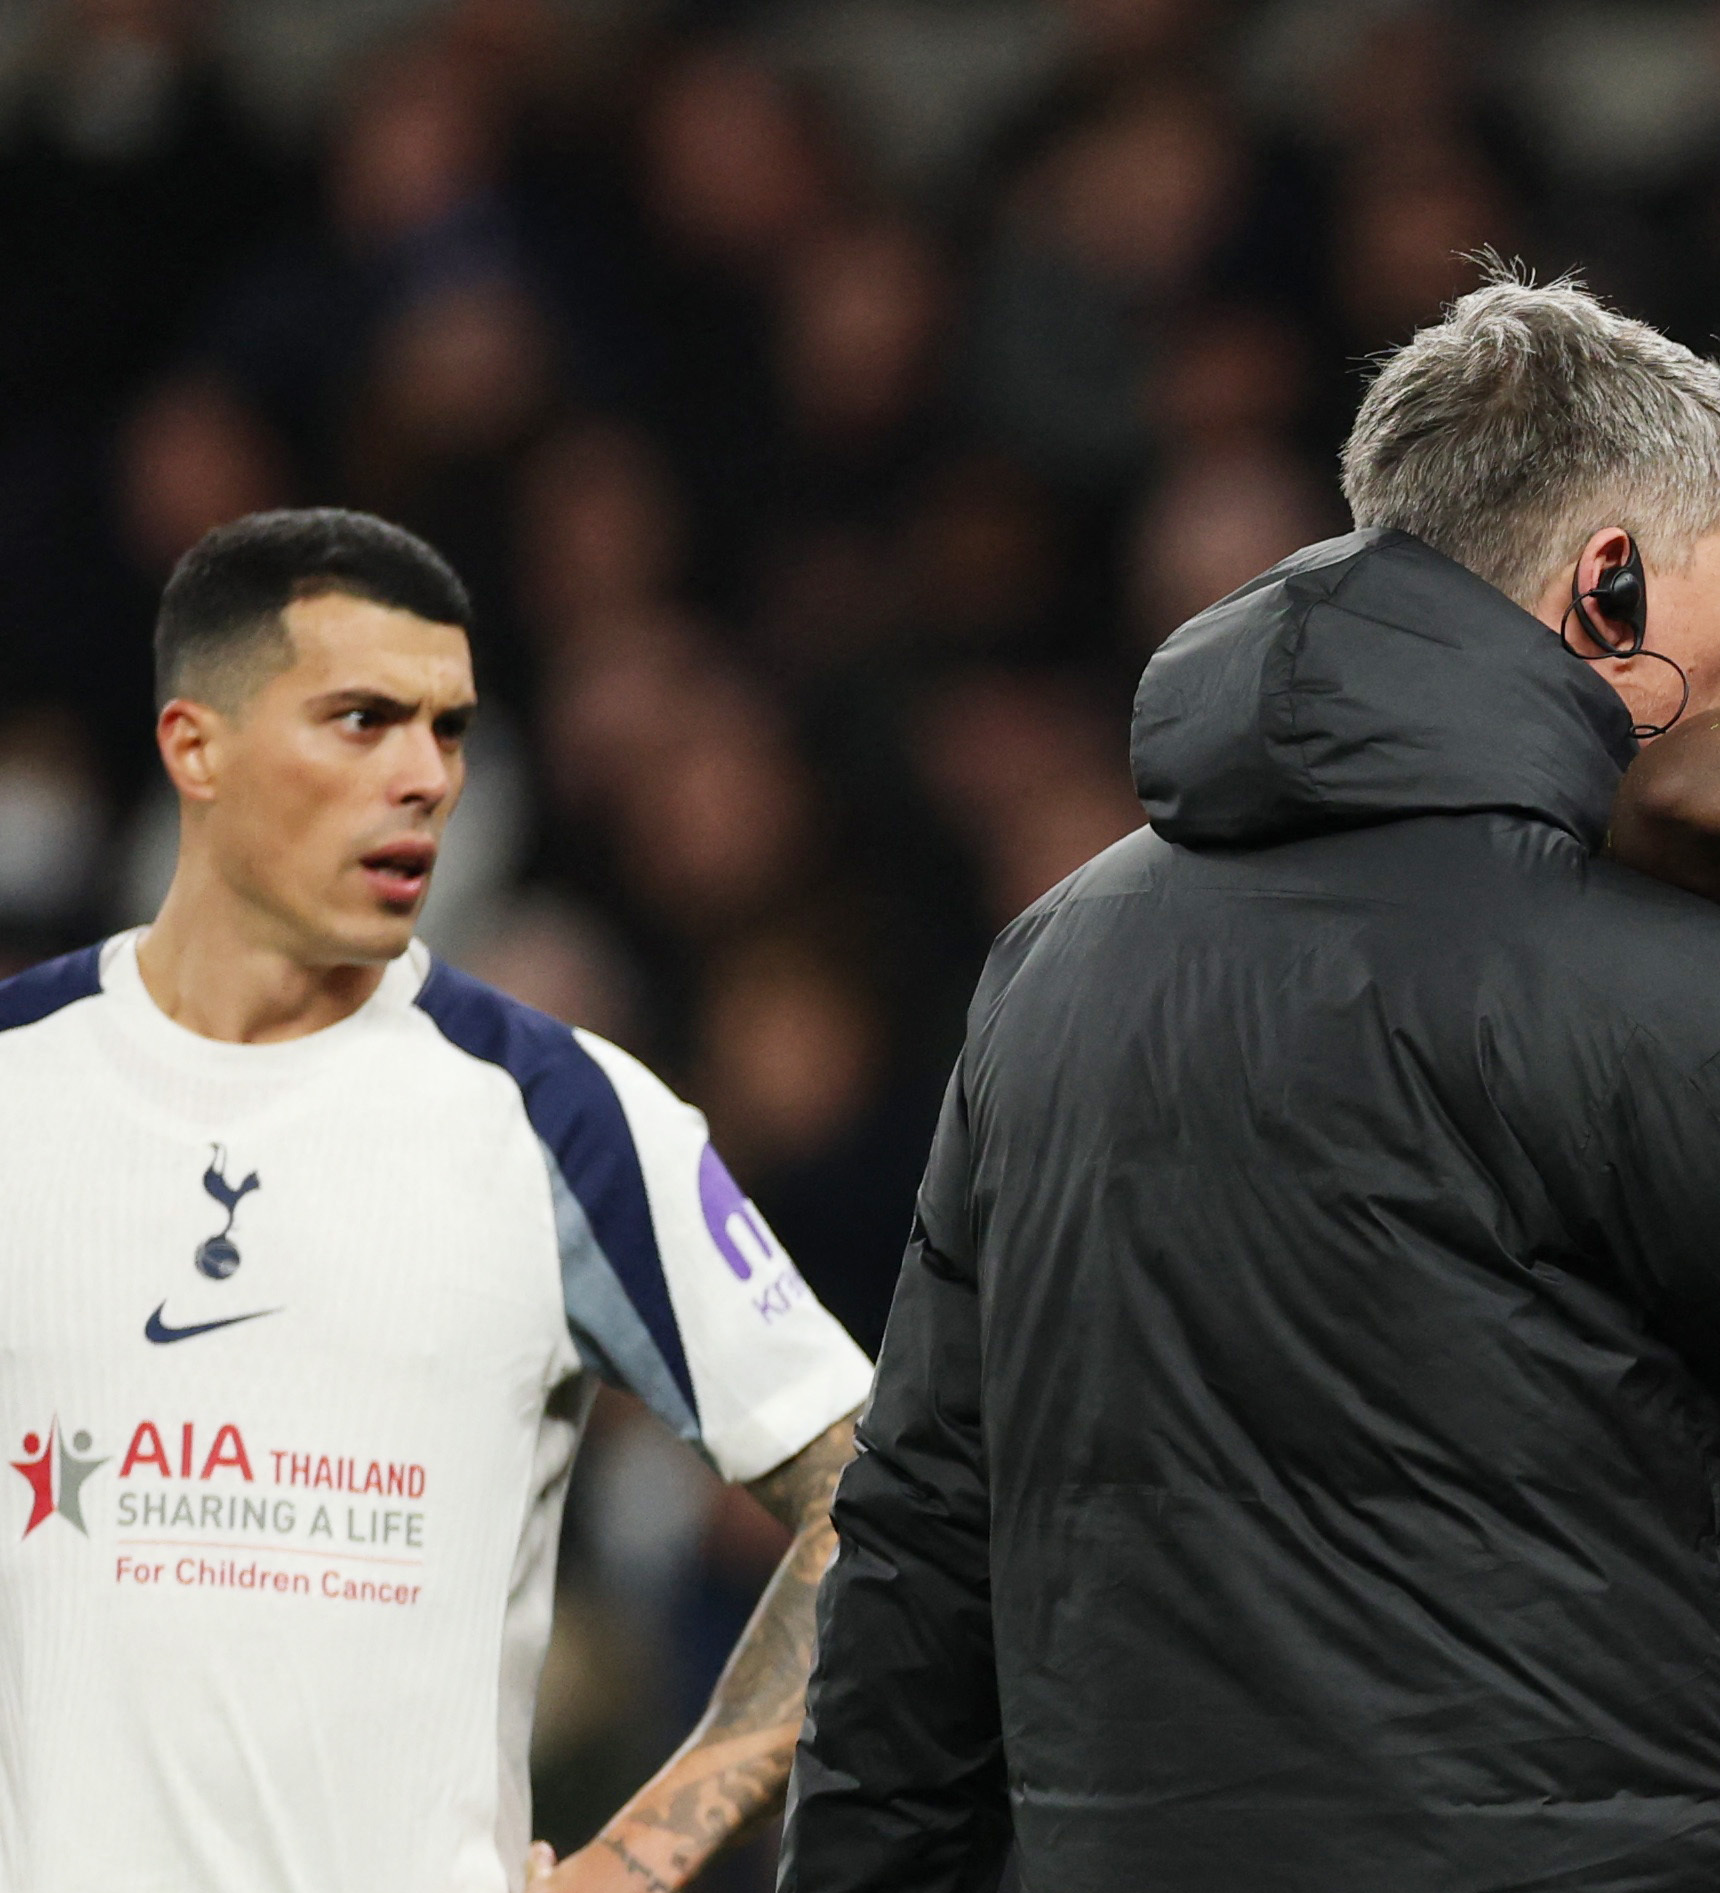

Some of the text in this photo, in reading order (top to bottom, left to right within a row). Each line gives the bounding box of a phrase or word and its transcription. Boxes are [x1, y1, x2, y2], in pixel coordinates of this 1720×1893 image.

[118, 1419, 426, 1500] AIA THAILAND
[116, 1491, 424, 1548] SHARING A LIFE
[115, 1556, 423, 1605] For Children Cancer
